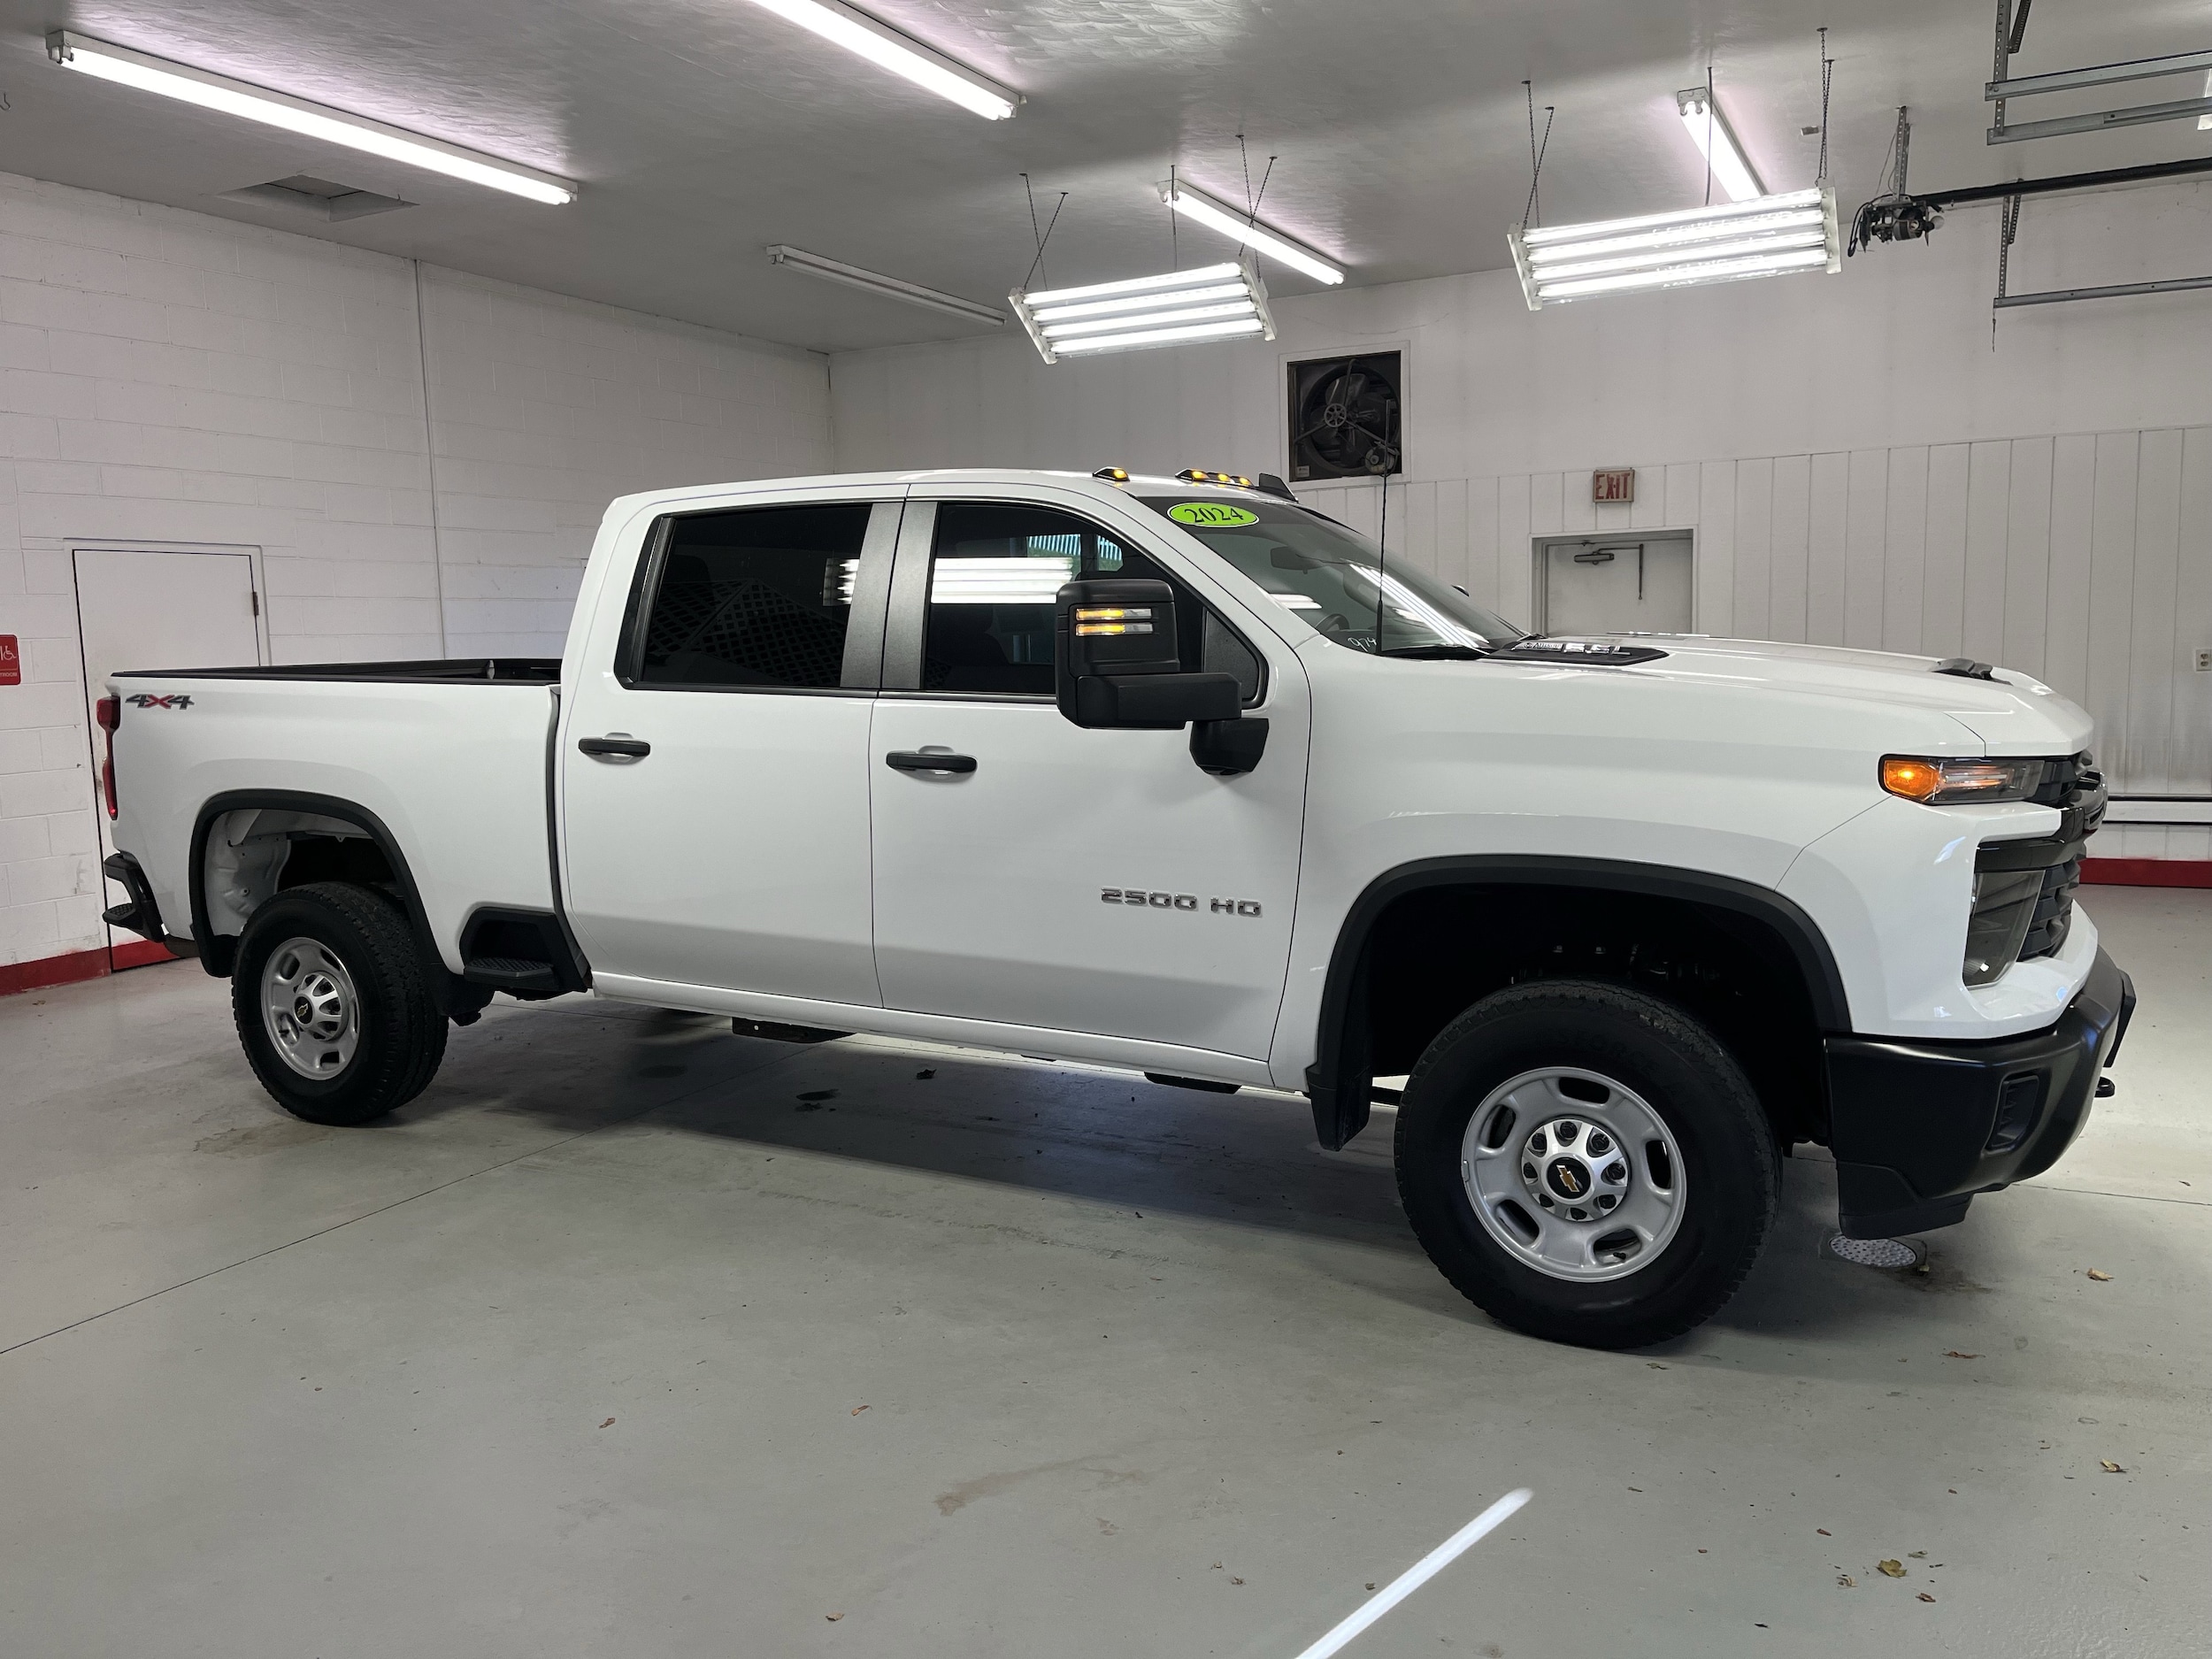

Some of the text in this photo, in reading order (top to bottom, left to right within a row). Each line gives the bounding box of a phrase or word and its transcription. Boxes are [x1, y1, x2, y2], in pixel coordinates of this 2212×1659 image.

[1595, 472, 1630, 499] EXIT
[1184, 507, 1244, 523] 2024
[1102, 887, 1262, 917] 2500 HD
